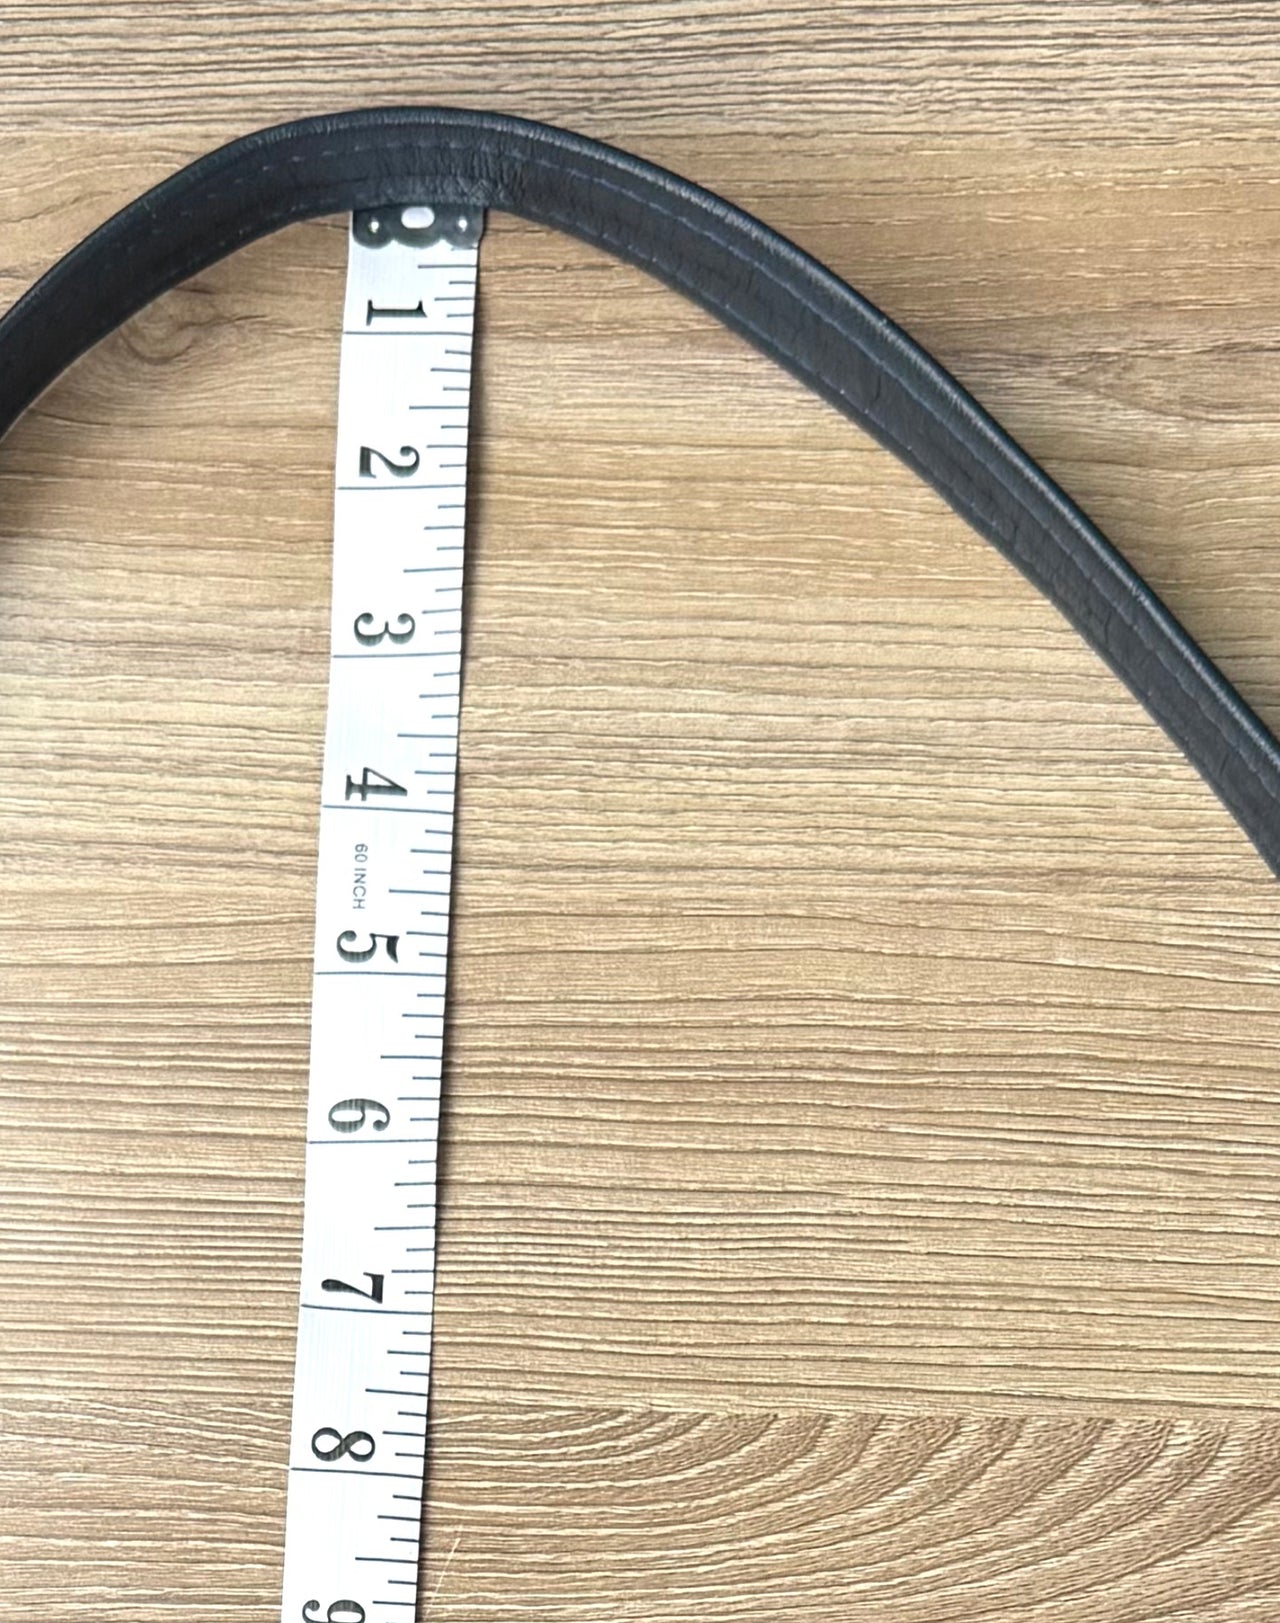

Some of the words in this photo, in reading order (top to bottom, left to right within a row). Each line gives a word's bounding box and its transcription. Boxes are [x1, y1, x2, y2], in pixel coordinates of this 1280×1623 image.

[367, 299, 426, 326] 1
[359, 445, 421, 479] 2
[353, 612, 416, 648] 3
[345, 767, 408, 802] 4
[354, 843, 369, 864] 60
[352, 866, 368, 910] INCH
[336, 930, 399, 963] 5
[328, 1098, 391, 1133] 6
[321, 1271, 384, 1304] 7
[311, 1427, 376, 1462] 8
